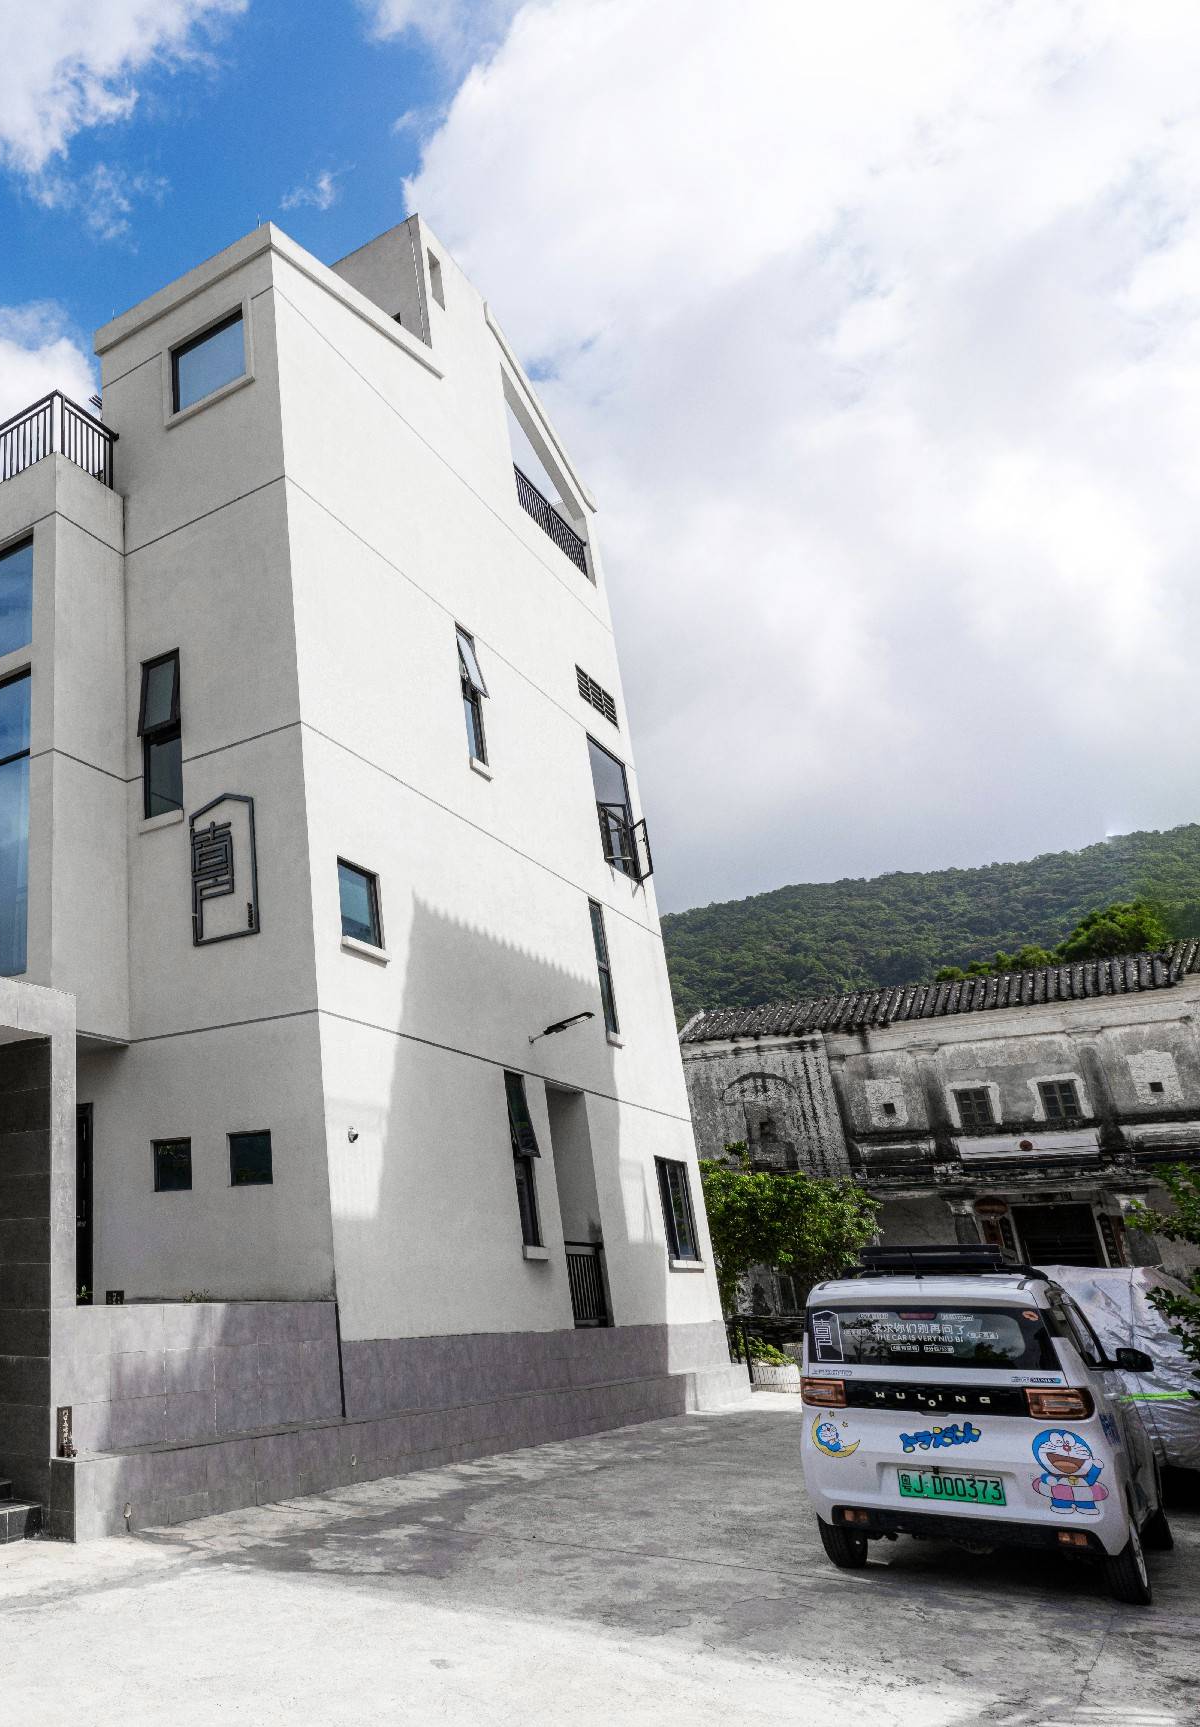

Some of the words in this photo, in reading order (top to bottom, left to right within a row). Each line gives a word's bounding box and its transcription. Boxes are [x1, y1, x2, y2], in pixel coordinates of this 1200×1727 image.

[872, 1323, 965, 1335] 求求你们别再问了
[875, 1333, 891, 1341] THE
[875, 1391, 991, 1404] WULING
